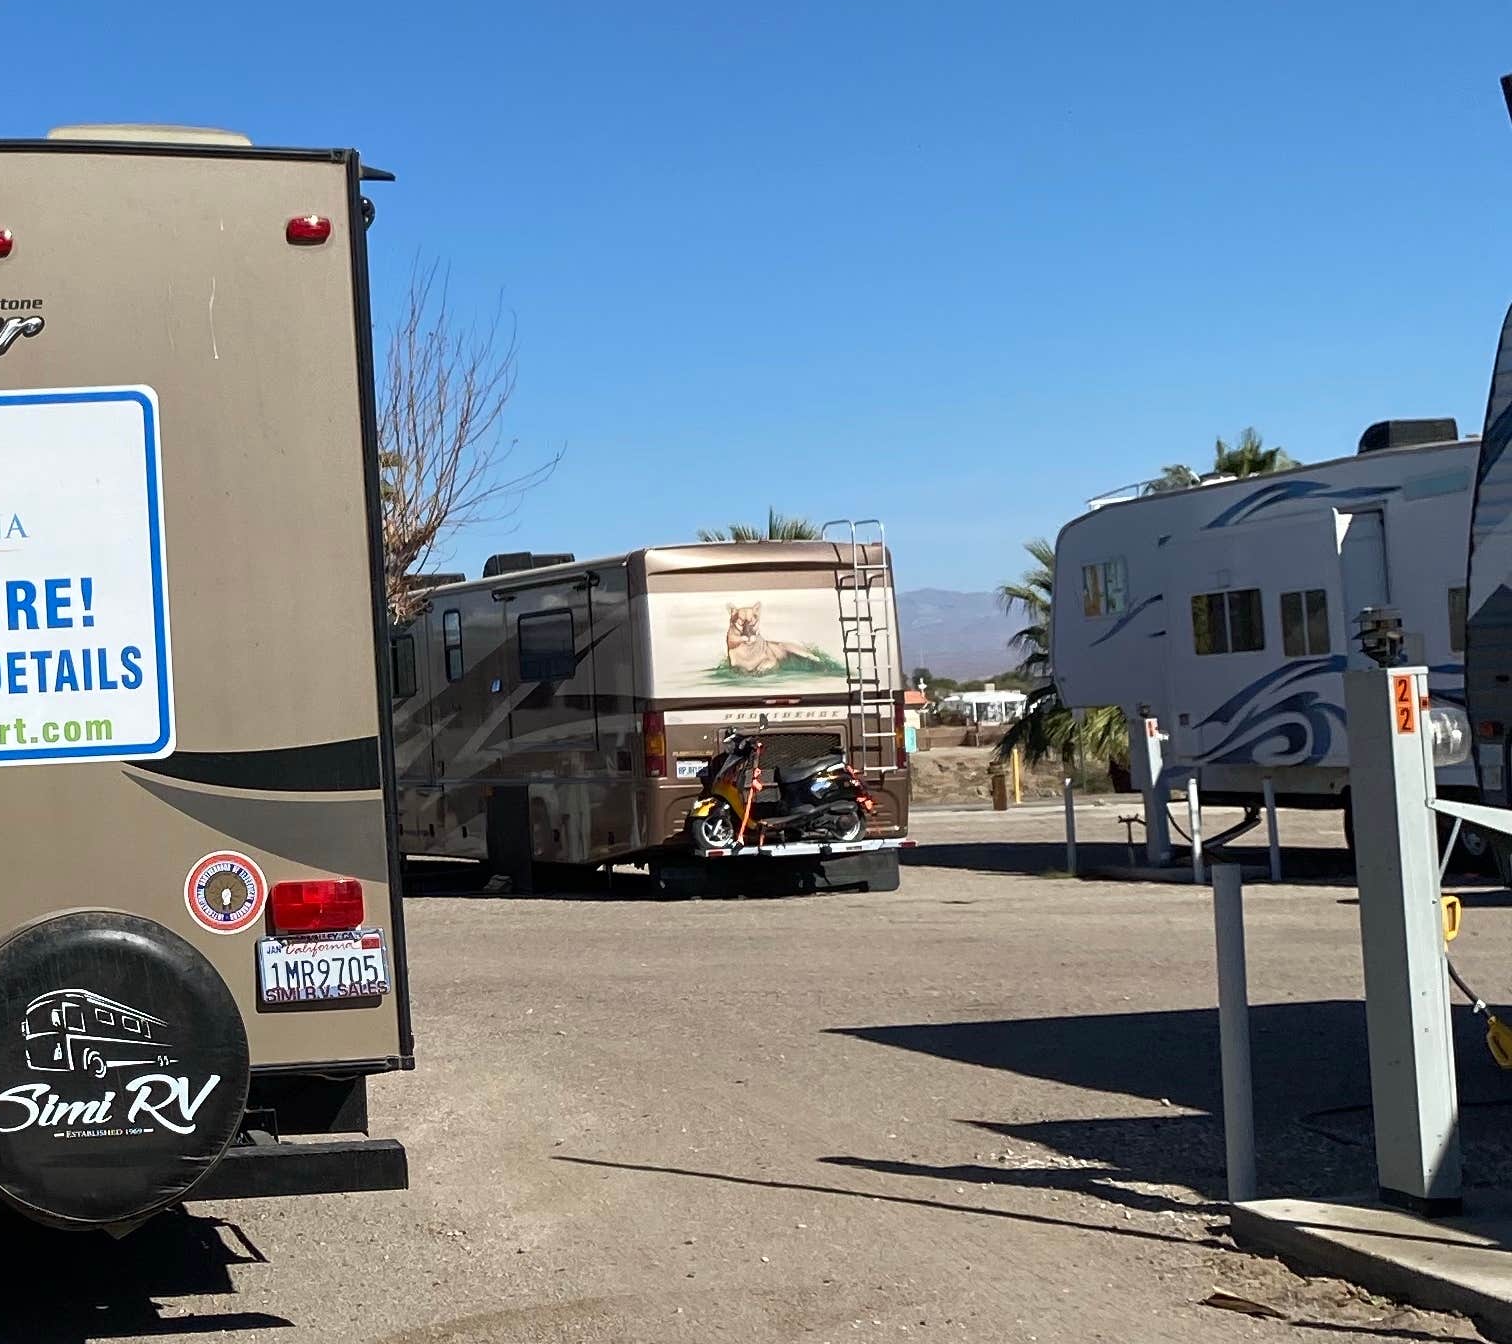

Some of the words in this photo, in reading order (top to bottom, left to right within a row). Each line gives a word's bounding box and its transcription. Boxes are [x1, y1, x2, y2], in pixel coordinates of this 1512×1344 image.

[271, 955, 379, 989] 1MR9705
[338, 980, 388, 997] SALES
[126, 1074, 221, 1135] RV
